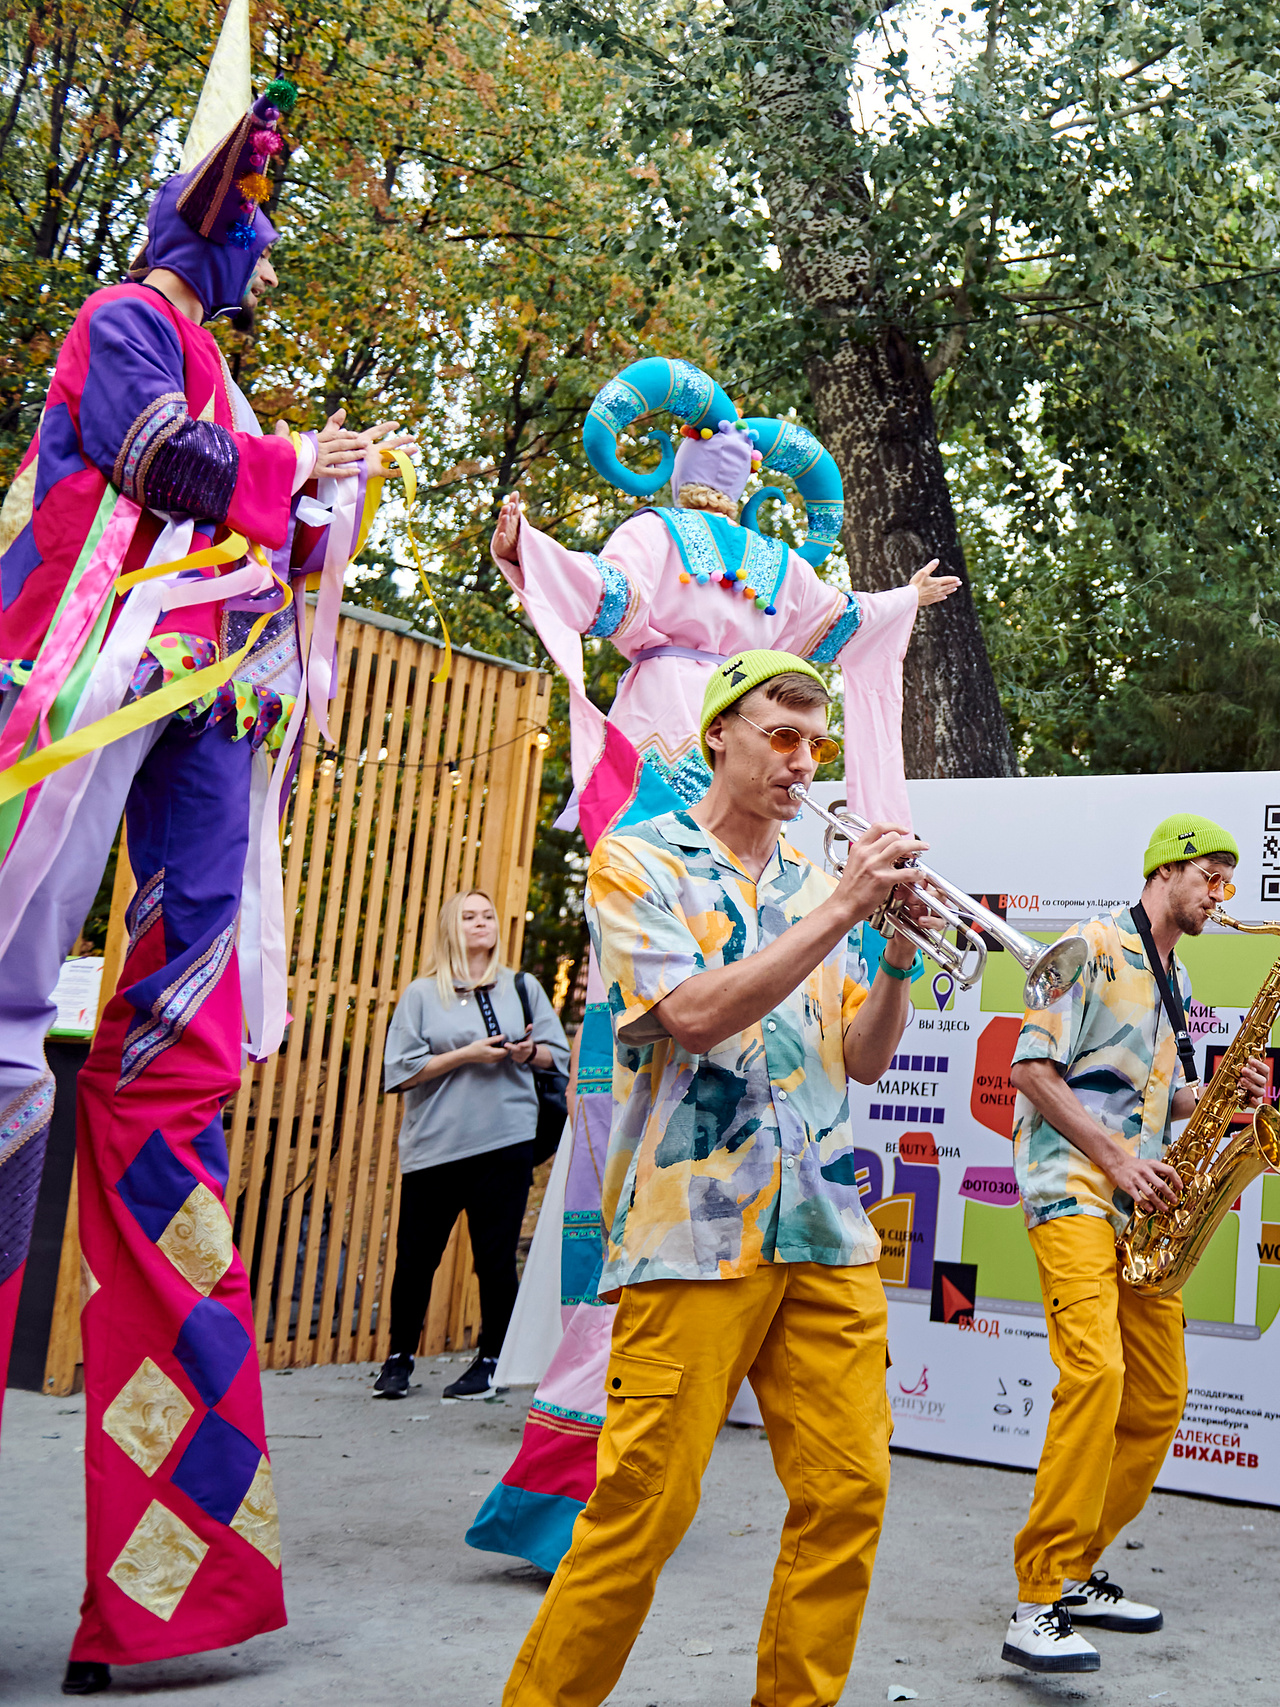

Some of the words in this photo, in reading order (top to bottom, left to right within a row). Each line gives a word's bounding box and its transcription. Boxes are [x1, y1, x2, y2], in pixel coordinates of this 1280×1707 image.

[998, 894, 1039, 912] ВХОД
[1052, 900, 1085, 908] стороны
[918, 1019, 934, 1030] ВЫ
[937, 1020, 970, 1032] ЗДЕСЬ
[876, 1080, 939, 1097] МАРКЕТ
[885, 1142, 928, 1156] BEAUTY
[930, 1145, 960, 1158] ЗОНА
[888, 1231, 924, 1243] СЦЕНА
[958, 1315, 1000, 1339] ВХОД
[1015, 1328, 1048, 1340] стороны
[1194, 1388, 1244, 1401] ПОДДЕРЖКЕ
[1214, 1404, 1262, 1417] городской
[1182, 1413, 1248, 1429] Екатеринбурга
[1174, 1428, 1240, 1448] АЛЕКСЕЙ
[1173, 1443, 1258, 1469] ВИХАРЕВ
